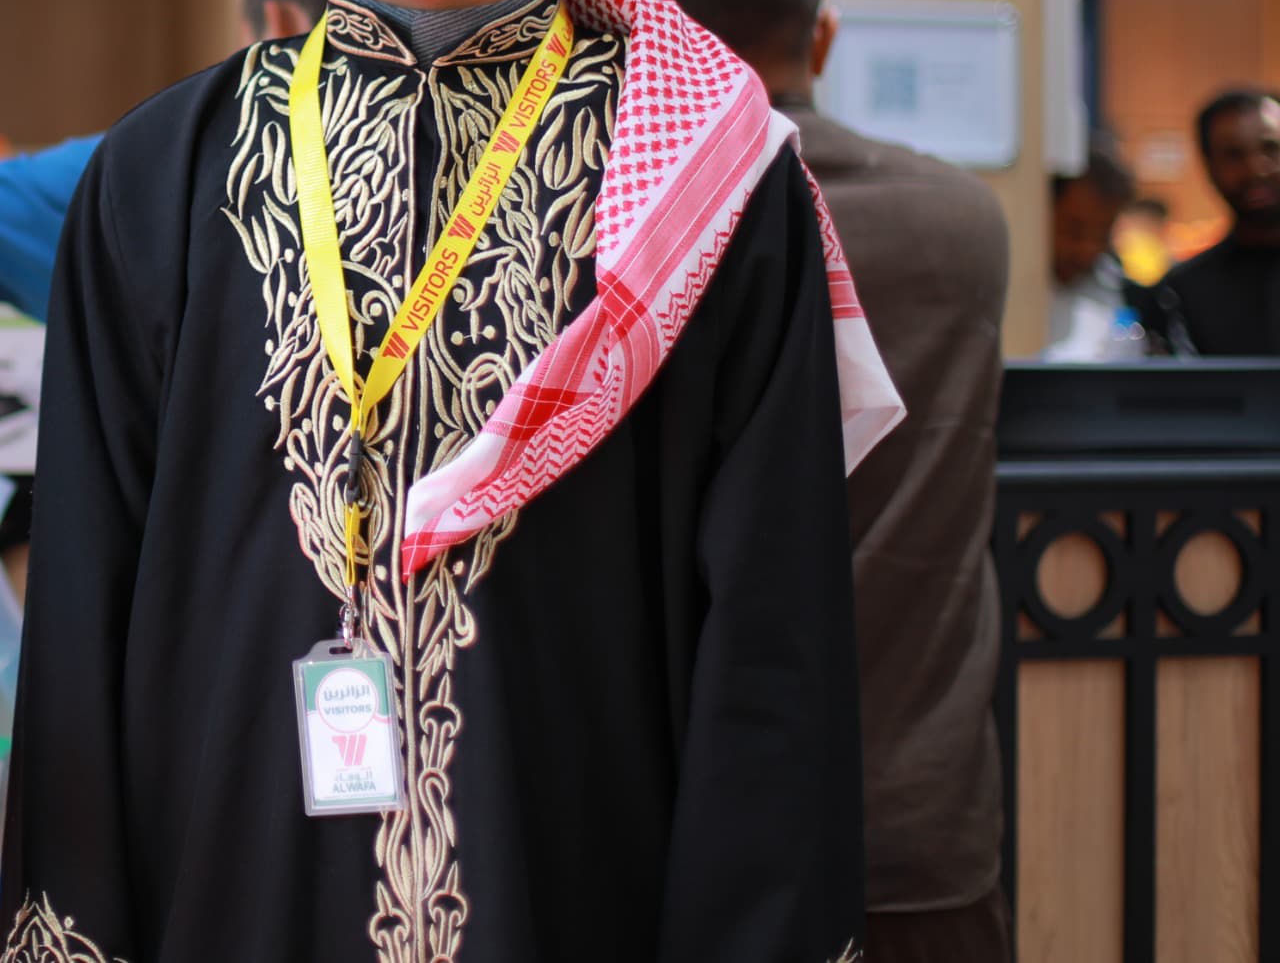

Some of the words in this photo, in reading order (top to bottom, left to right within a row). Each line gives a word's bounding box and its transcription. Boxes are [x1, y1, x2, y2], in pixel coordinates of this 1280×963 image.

[511, 58, 557, 129] VISITORS
[469, 161, 502, 217] الزائرين
[402, 247, 459, 332] VISITORS
[324, 703, 372, 716] VISITORS
